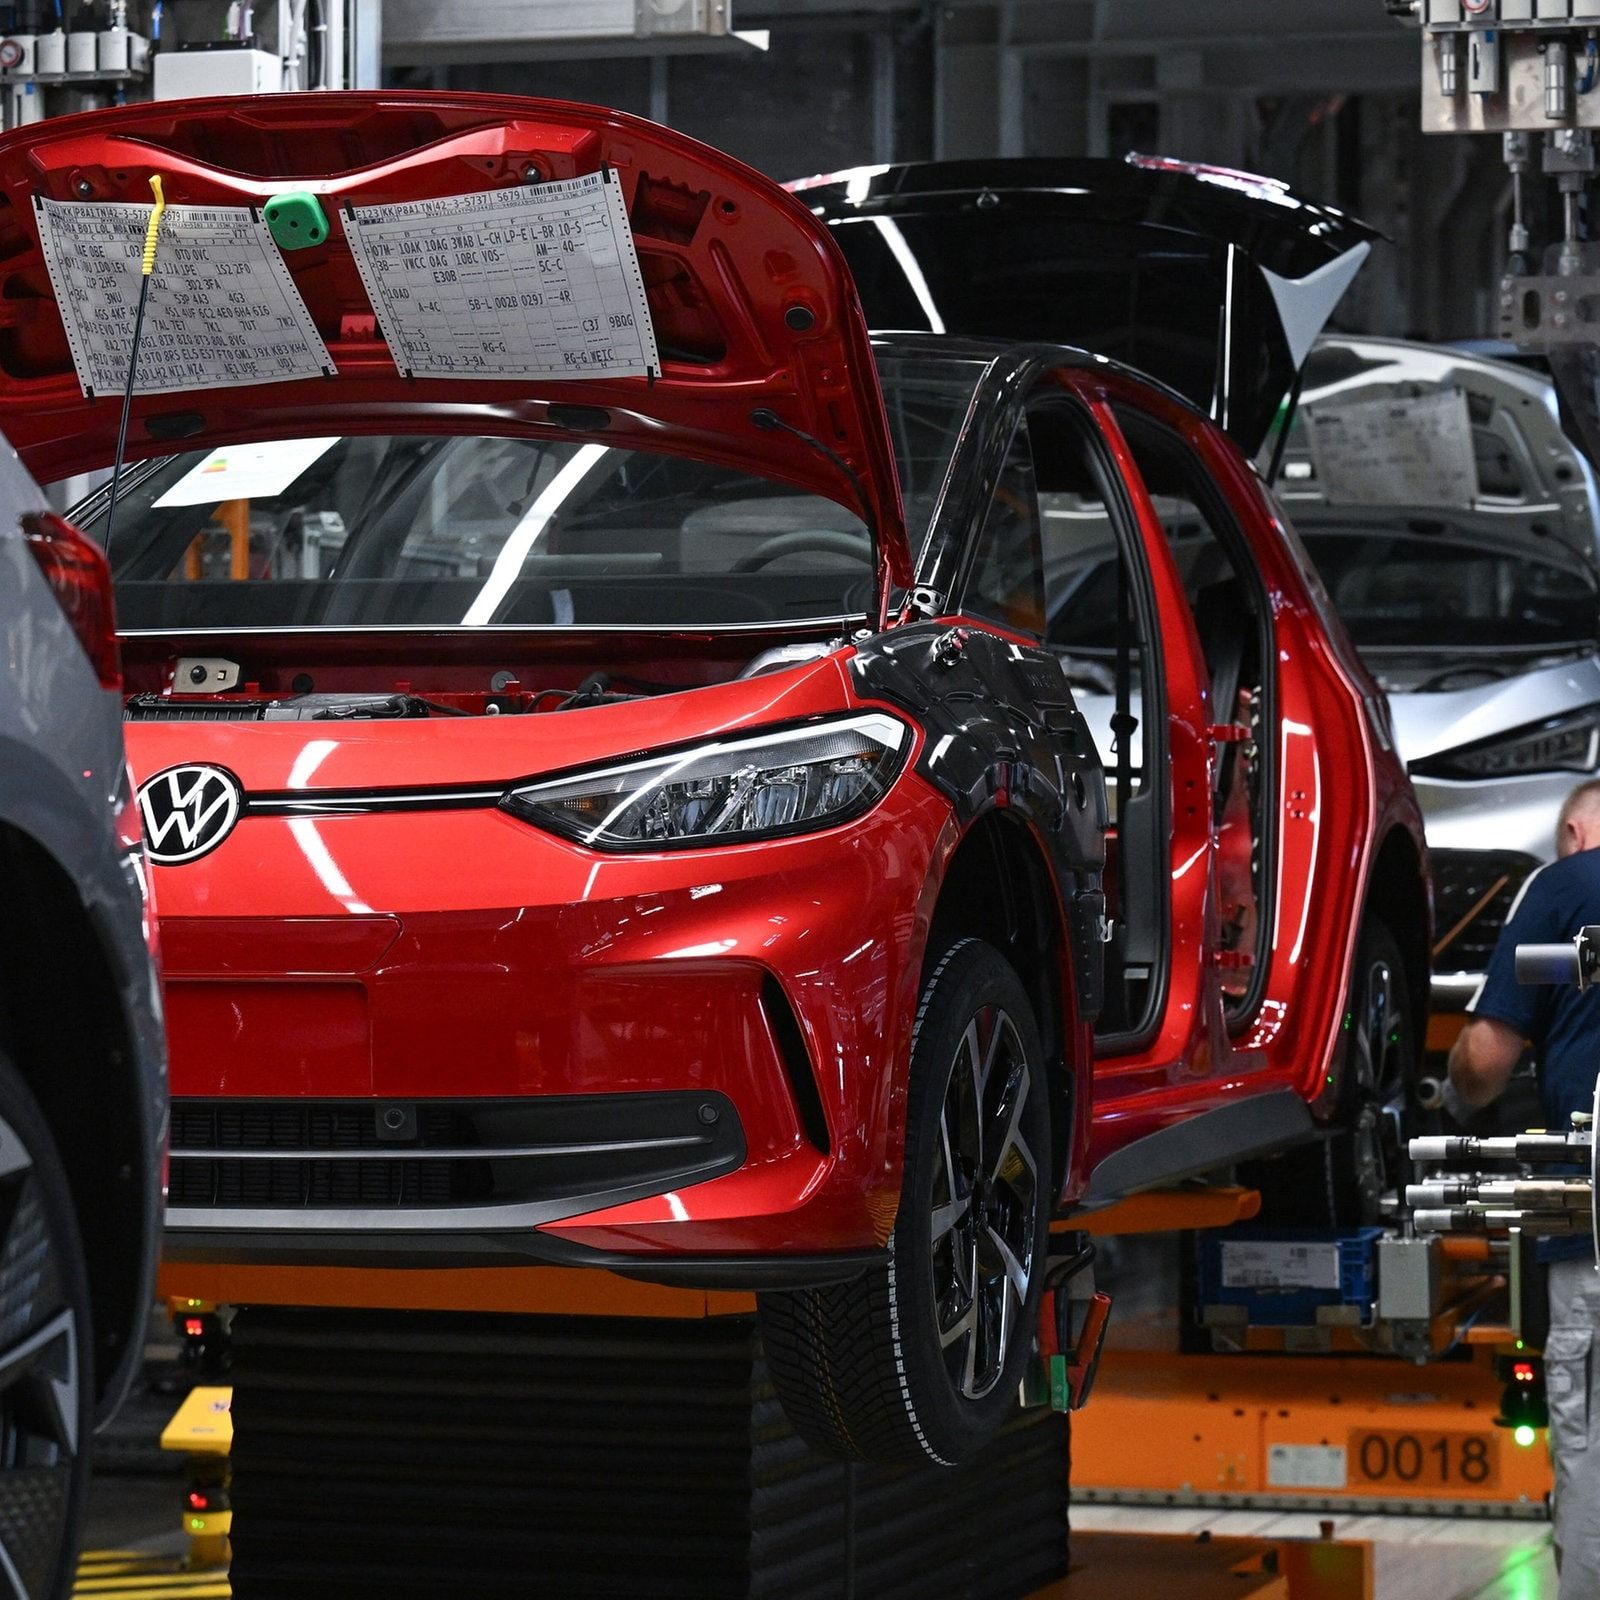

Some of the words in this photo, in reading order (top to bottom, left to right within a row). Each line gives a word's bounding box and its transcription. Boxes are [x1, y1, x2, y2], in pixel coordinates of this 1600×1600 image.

[355, 208, 380, 220] E123
[382, 207, 396, 218] KK
[435, 194, 488, 211] 42-3-5737
[497, 190, 520, 202] 5679
[398, 241, 422, 255] 10AK
[424, 238, 448, 252] 10AG
[477, 232, 502, 246] L-CH
[504, 228, 528, 243] LP-E
[530, 225, 554, 240] L-BR
[538, 258, 563, 272] 5C-C
[418, 301, 441, 312] A-4C
[468, 298, 492, 311] 5B-L
[482, 342, 506, 353] RG-G
[564, 352, 588, 364] RG-G
[137, 766, 237, 859] VW
[1360, 1434, 1490, 1483] 0018
